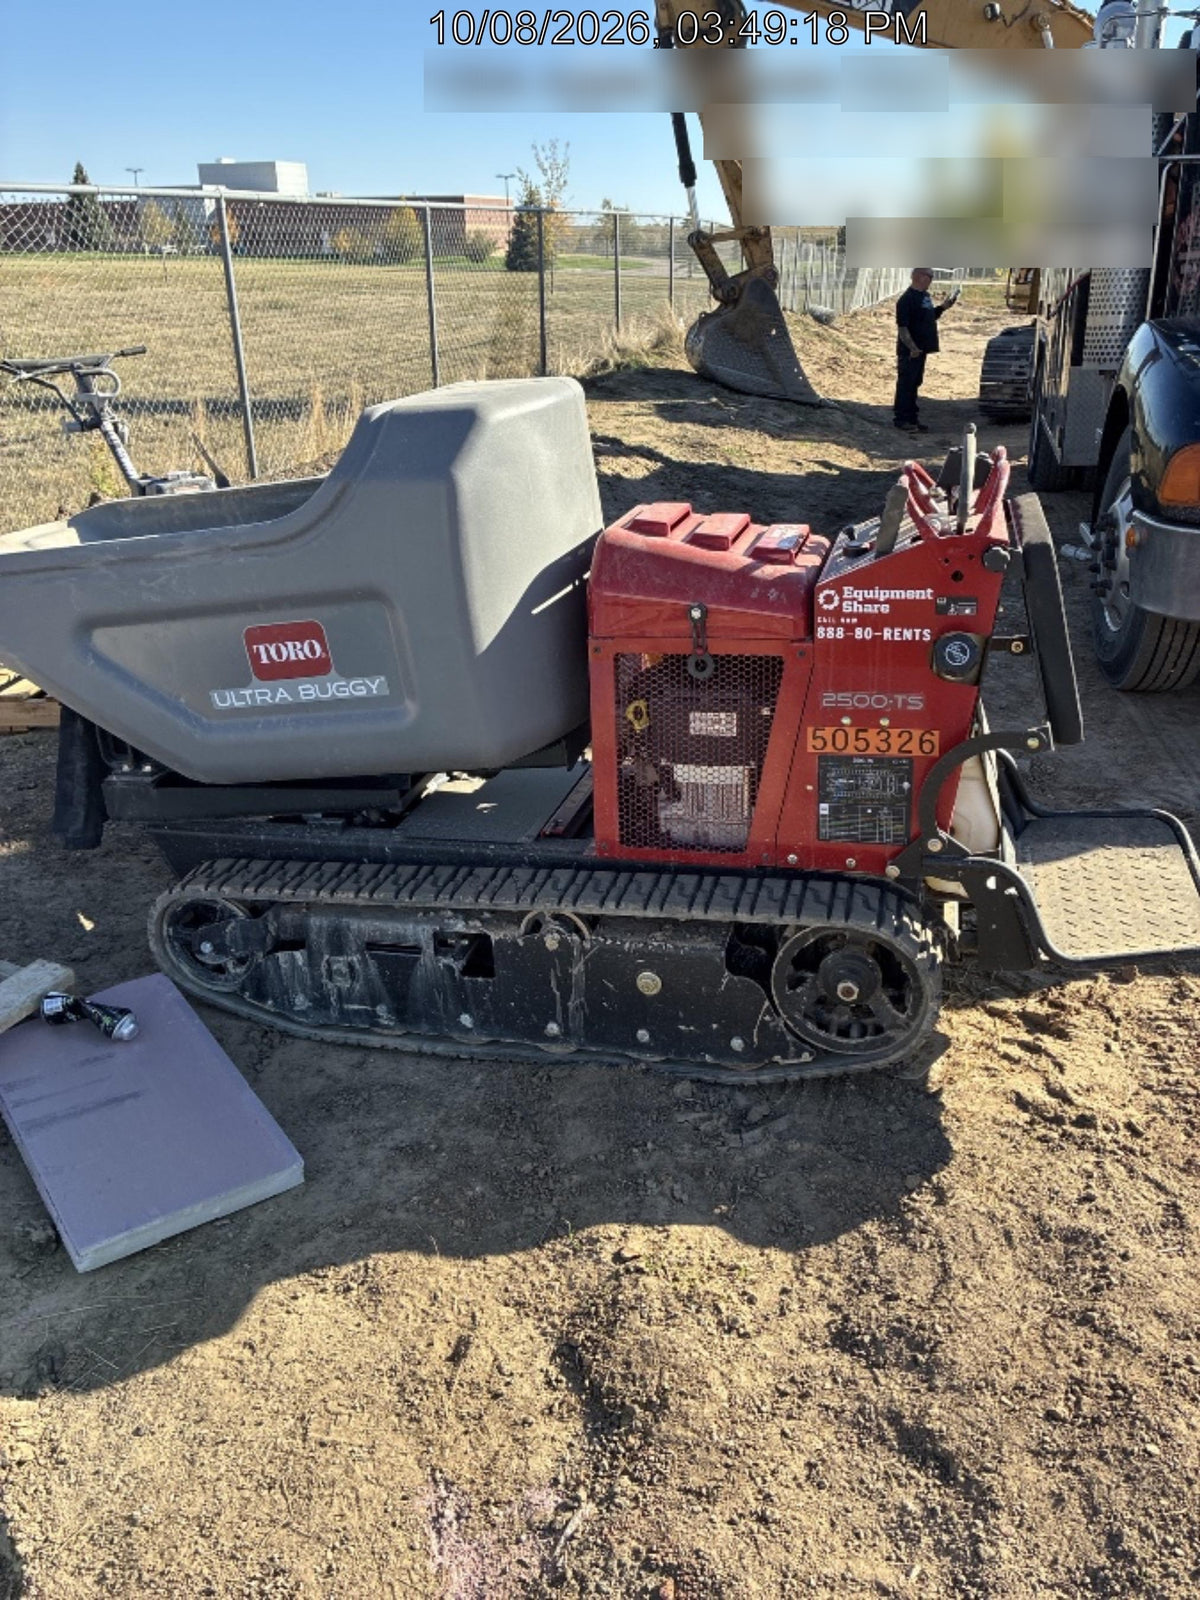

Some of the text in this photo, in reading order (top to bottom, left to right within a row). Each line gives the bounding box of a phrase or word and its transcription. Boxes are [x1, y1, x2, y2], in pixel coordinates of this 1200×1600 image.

[842, 586, 934, 602] Equipment
[842, 600, 890, 614] Share
[817, 626, 932, 642] 888-80-RENTS
[253, 639, 323, 664] TORO
[214, 679, 381, 707] ULTRA BUGGY
[812, 728, 936, 755] 505326
